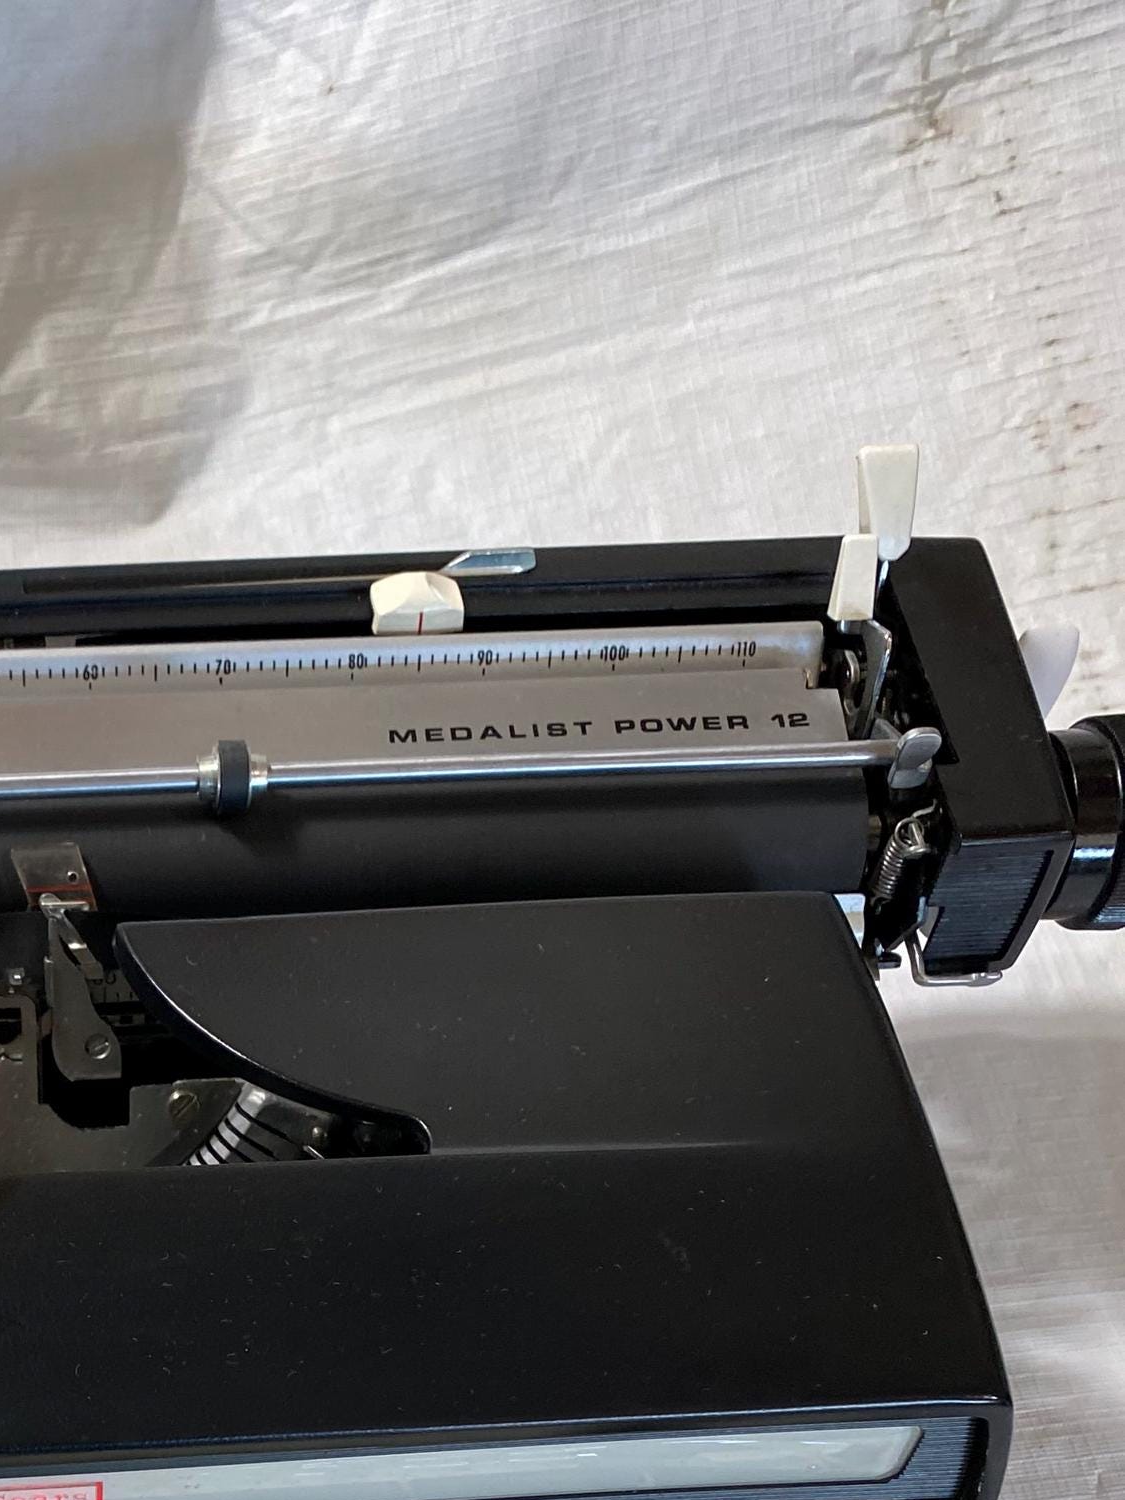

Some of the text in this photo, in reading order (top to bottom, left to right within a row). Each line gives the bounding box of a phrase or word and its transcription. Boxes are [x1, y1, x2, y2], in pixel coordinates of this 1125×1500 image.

[83, 664, 99, 681] 60
[215, 660, 231, 675] 70
[348, 653, 364, 669] 80
[477, 650, 493, 666] 90
[604, 645, 626, 661] 100
[737, 642, 756, 657] 110
[388, 712, 810, 744] MEDALIST POWER 12
